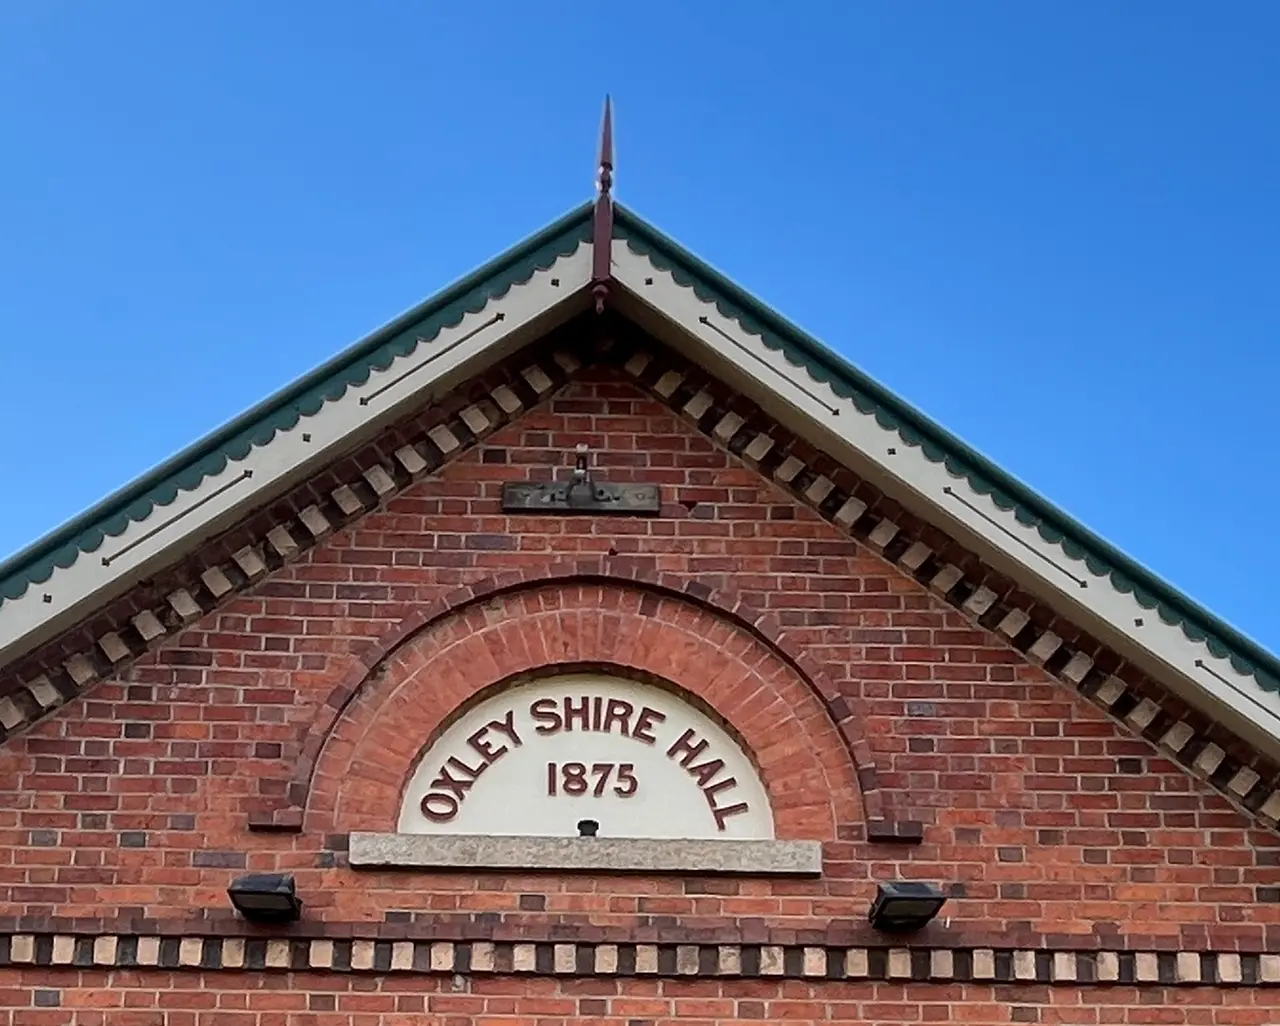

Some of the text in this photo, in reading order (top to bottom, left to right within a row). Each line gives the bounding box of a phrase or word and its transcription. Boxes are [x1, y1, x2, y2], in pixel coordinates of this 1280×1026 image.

[420, 696, 749, 833] OXLEY SHIRE HALL
[547, 762, 639, 799] 1875
